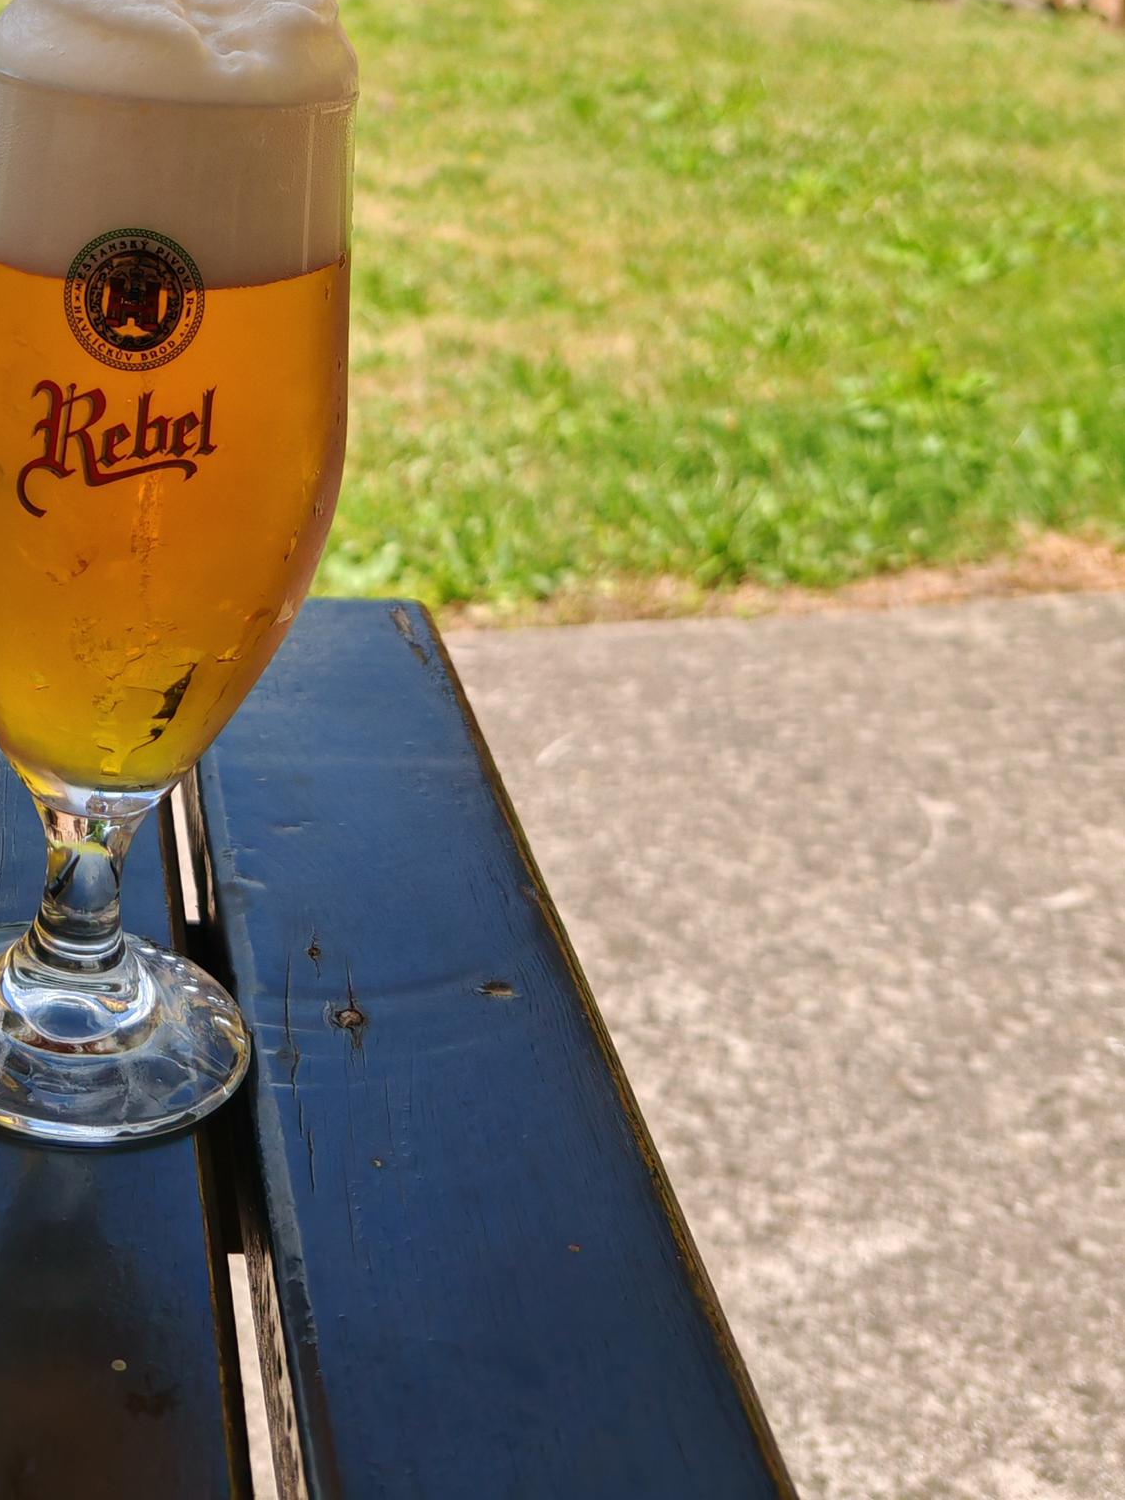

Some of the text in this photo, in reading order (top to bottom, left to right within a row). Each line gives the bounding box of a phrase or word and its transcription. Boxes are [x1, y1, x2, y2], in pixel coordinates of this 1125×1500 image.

[155, 246, 194, 304] PIVOVAR
[141, 340, 176, 360] BROD
[17, 380, 217, 517] Rebel
